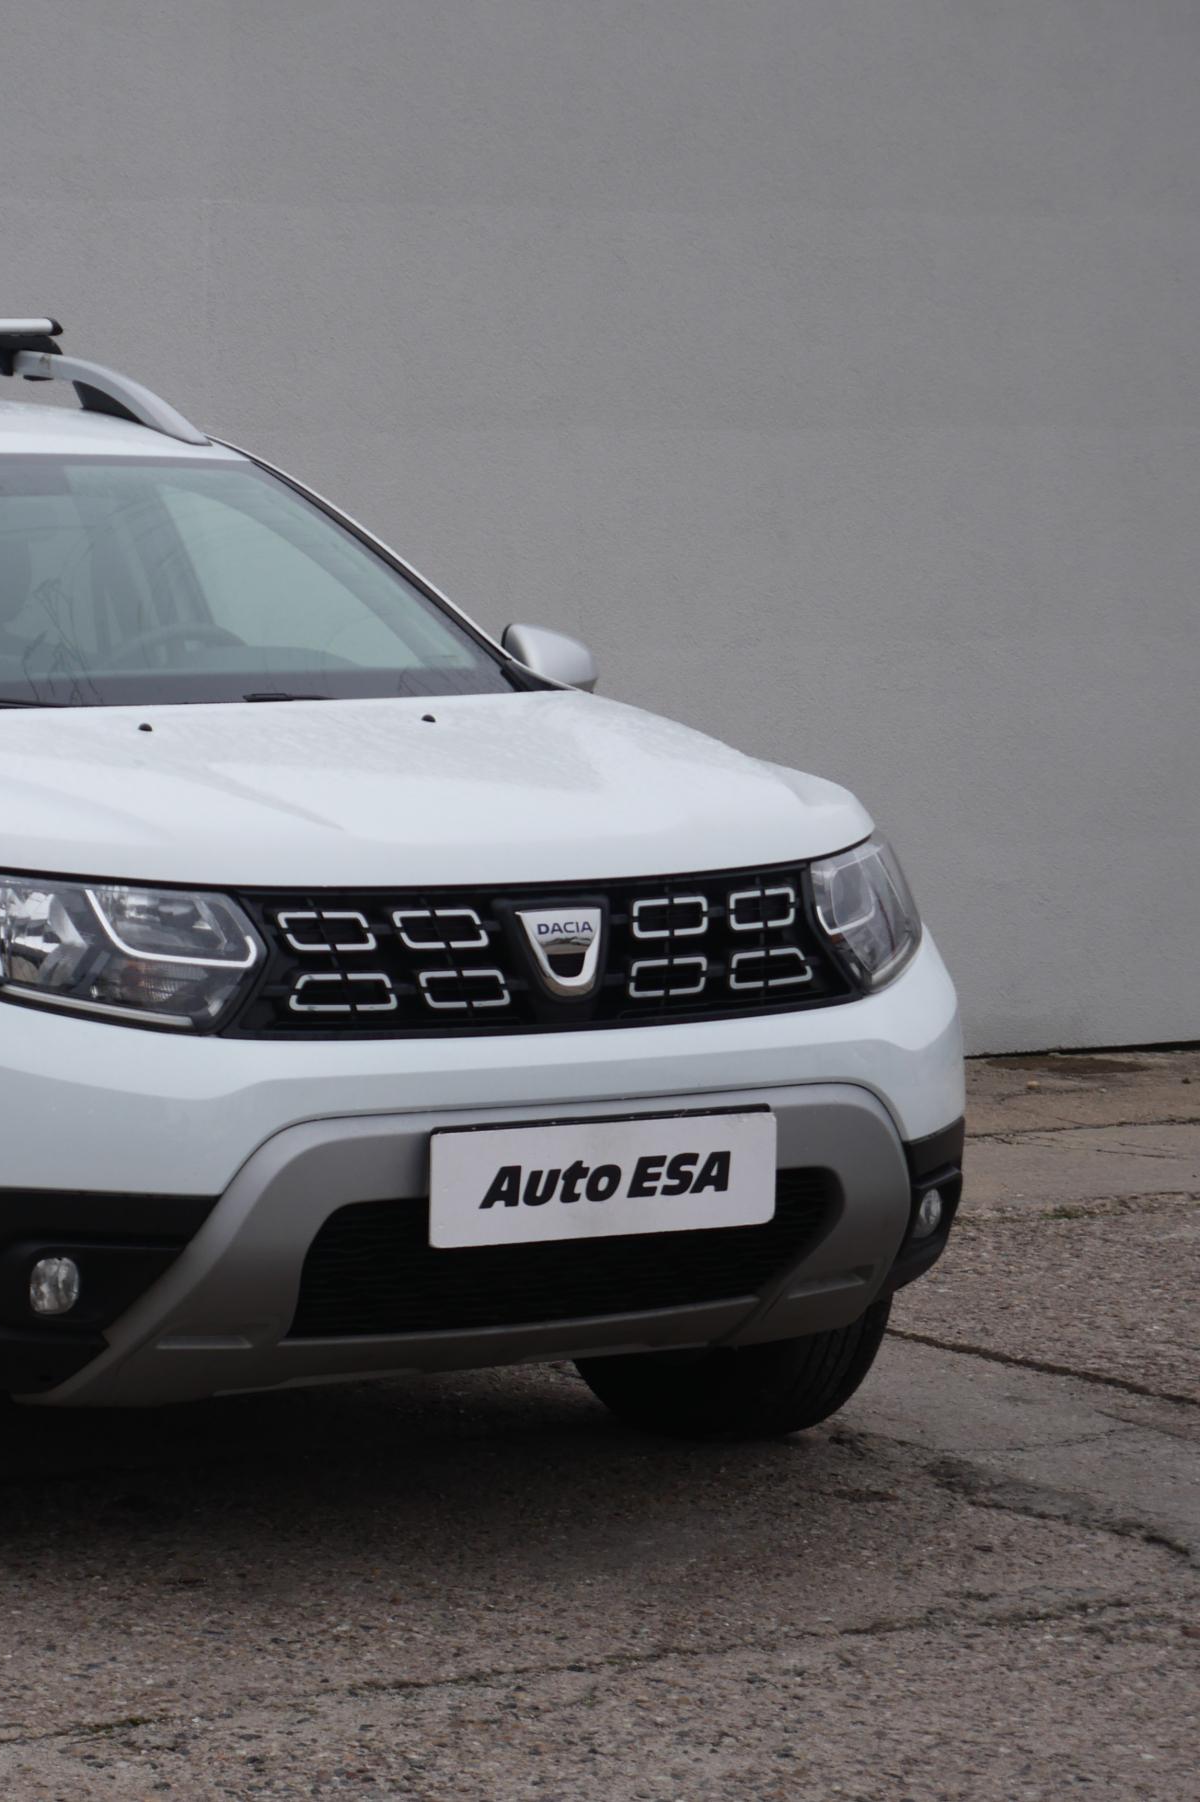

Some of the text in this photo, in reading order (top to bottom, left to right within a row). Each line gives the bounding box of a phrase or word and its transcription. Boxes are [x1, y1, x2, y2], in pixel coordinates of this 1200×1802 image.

[537, 921, 593, 935] DACIA
[478, 1151, 731, 1209] Auto ESA
